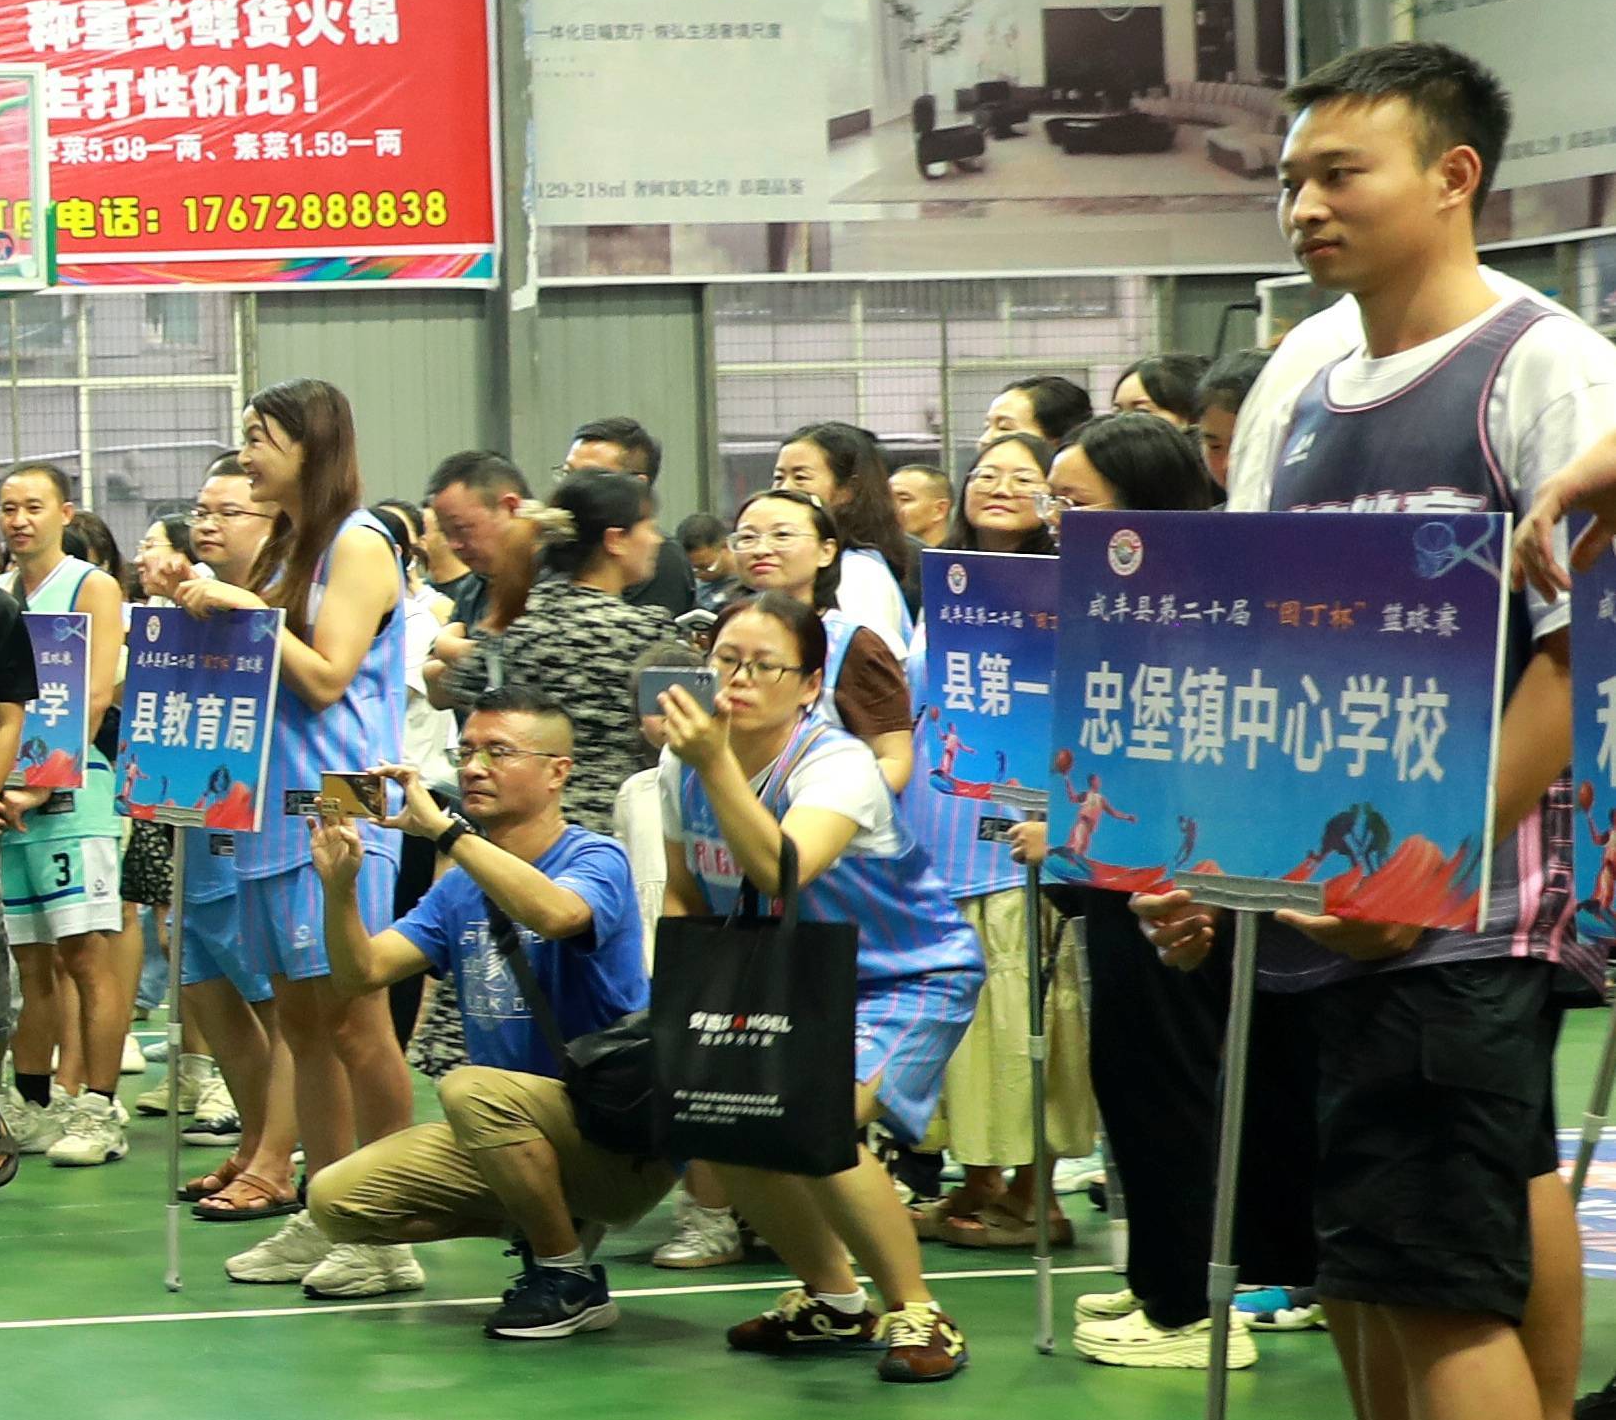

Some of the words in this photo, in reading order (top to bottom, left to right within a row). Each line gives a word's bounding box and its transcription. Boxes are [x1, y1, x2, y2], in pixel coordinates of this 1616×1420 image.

[181, 189, 449, 236] 17672888838
[1086, 591, 1250, 627] 咸丰县第二十届
[1378, 602, 1462, 637] 篮球赛
[130, 690, 259, 753] 县教育局
[1078, 660, 1450, 782] 忠堡镇中心学校
[52, 852, 72, 887] 3
